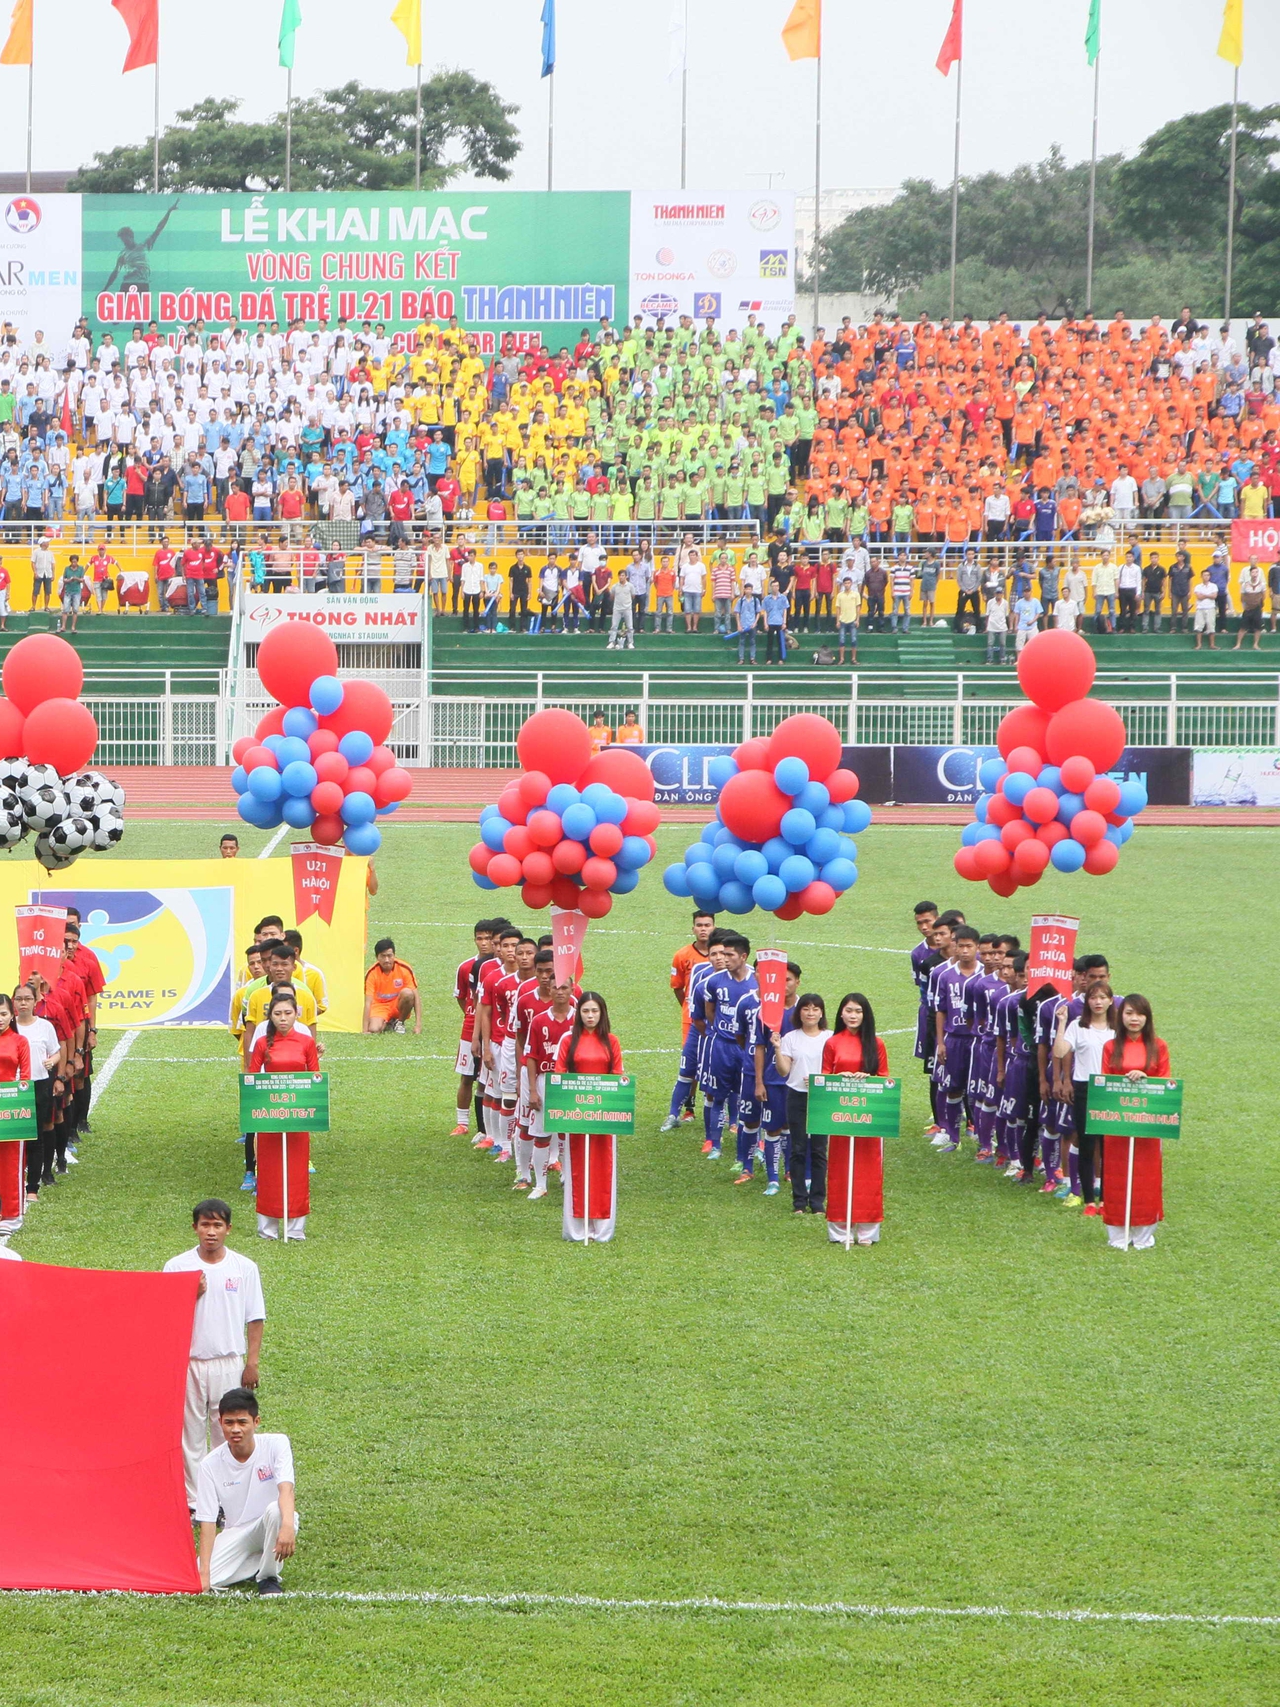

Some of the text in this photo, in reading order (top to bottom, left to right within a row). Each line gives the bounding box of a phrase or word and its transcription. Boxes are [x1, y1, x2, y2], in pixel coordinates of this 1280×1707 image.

[220, 196, 489, 246] LỄ KHAI MẠC
[246, 245, 461, 282] VÒNG CHUNG KẾT
[634, 272, 656, 281] TON
[657, 272, 684, 281] DONG
[761, 266, 787, 276] TSN
[28, 270, 78, 286] MEN
[97, 285, 152, 324] GIẢI
[158, 287, 233, 324] BÓNG
[239, 286, 277, 323] ĐÁ
[282, 284, 333, 322] TRẺ
[337, 289, 393, 322] U.21
[399, 286, 456, 321] BÁO
[365, 607, 418, 626] NHẤT
[327, 632, 389, 640] NGNHAT STADIUM
[645, 747, 717, 790] CLE
[654, 791, 712, 802] ĐÀN ÔNG
[947, 792, 972, 802] ĐÀN
[1042, 933, 1065, 946] U.21
[1030, 966, 1054, 978] THIÊN
[99, 989, 177, 999] GAME IS
[716, 987, 730, 1001] 31
[108, 1001, 154, 1010] PLAY
[718, 1019, 734, 1032] CLE
[952, 1015, 967, 1026] CLE
[540, 1061, 556, 1072] CLE
[575, 1094, 602, 1105] U.21
[839, 1095, 867, 1106] U.21
[739, 1099, 753, 1115] 22
[291, 1108, 317, 1119] T&T
[831, 1112, 873, 1124] GIA LAI
